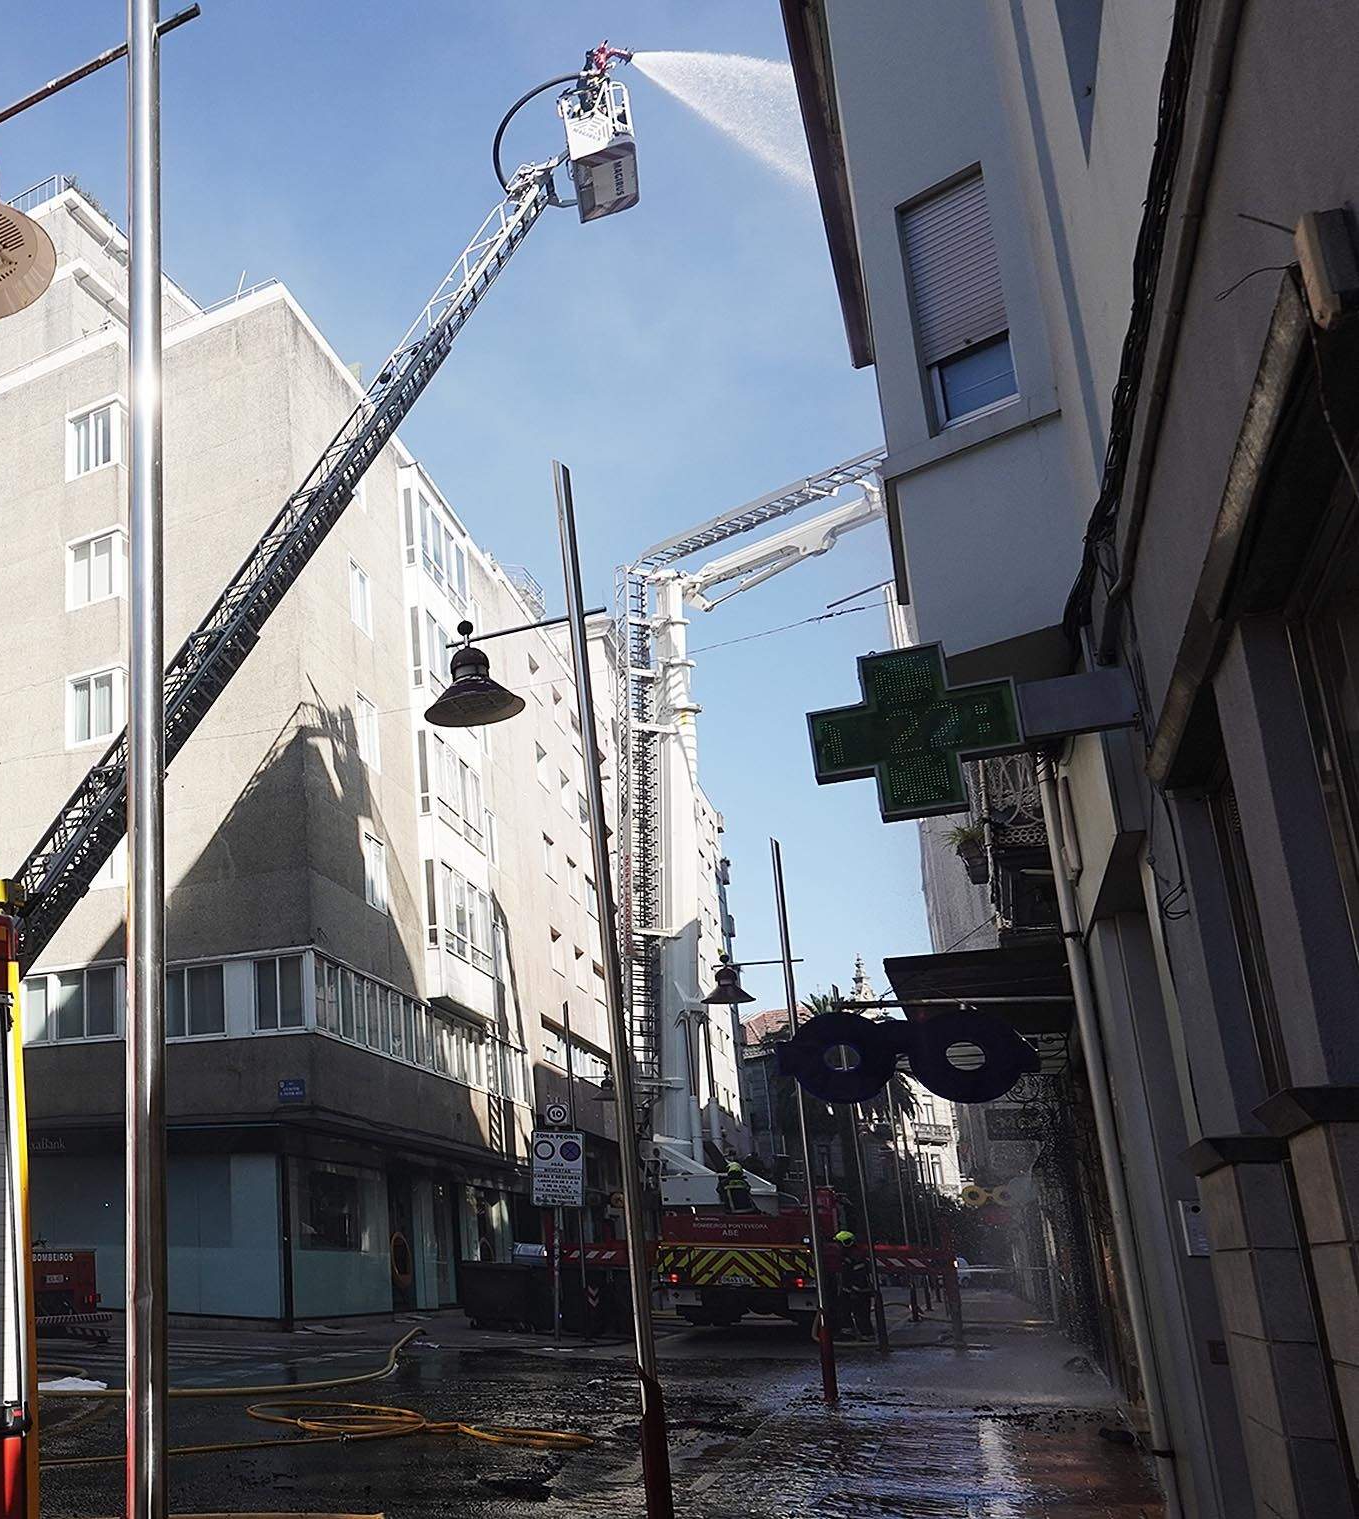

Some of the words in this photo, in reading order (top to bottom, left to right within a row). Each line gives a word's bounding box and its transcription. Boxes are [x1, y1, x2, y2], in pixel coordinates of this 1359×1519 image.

[613, 160, 625, 196] MAGIRUS
[551, 1110, 563, 1118] 10
[32, 1253, 74, 1262] BOMBEIROS
